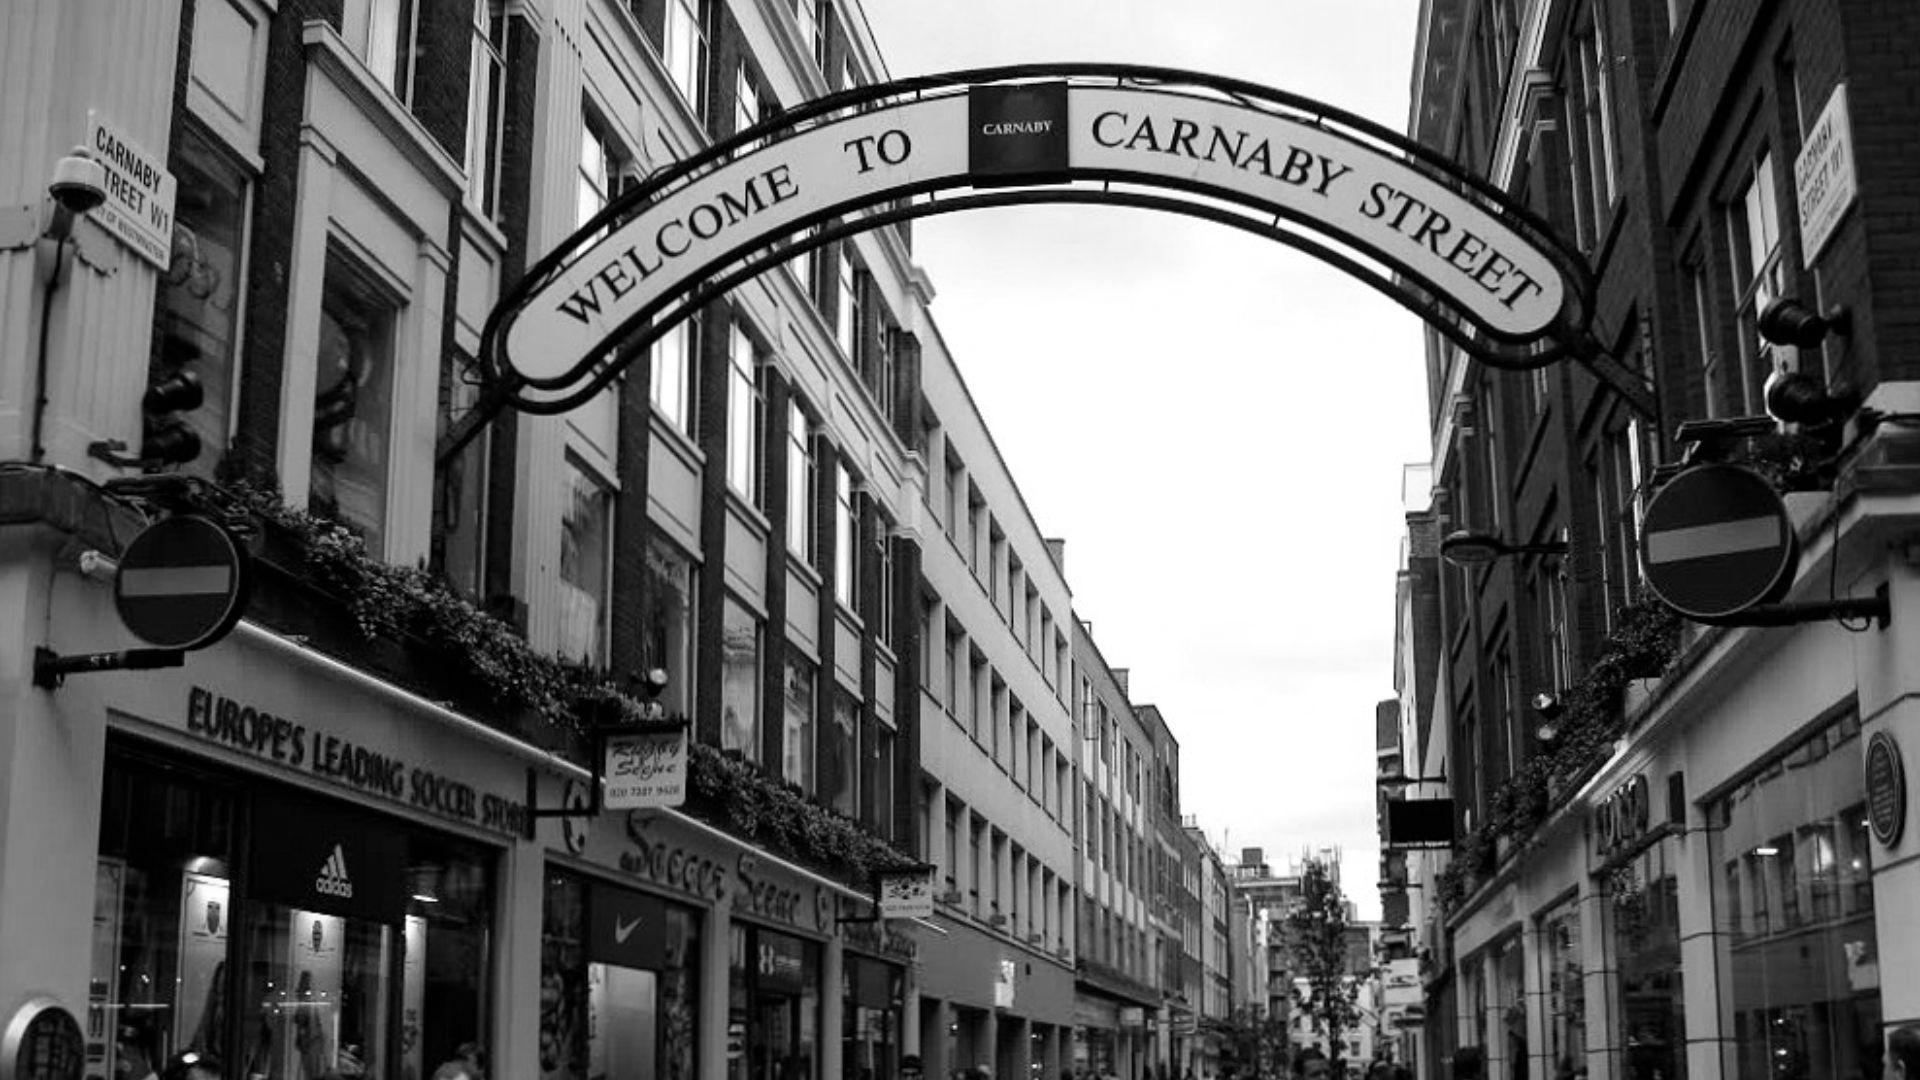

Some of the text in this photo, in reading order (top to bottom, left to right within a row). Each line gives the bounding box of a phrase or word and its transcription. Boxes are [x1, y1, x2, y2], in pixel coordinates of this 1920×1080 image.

[96, 126, 161, 195] CARNABY
[982, 120, 1053, 135] CARNABY
[95, 158, 169, 234] TREET W1
[556, 129, 912, 325] WELCOME TO
[1092, 111, 1543, 311] CARNABY STREET
[187, 686, 306, 765] EUROPE'S
[312, 731, 405, 796] LEADING
[411, 768, 476, 819] SOCCER
[315, 876, 353, 899] adidas
